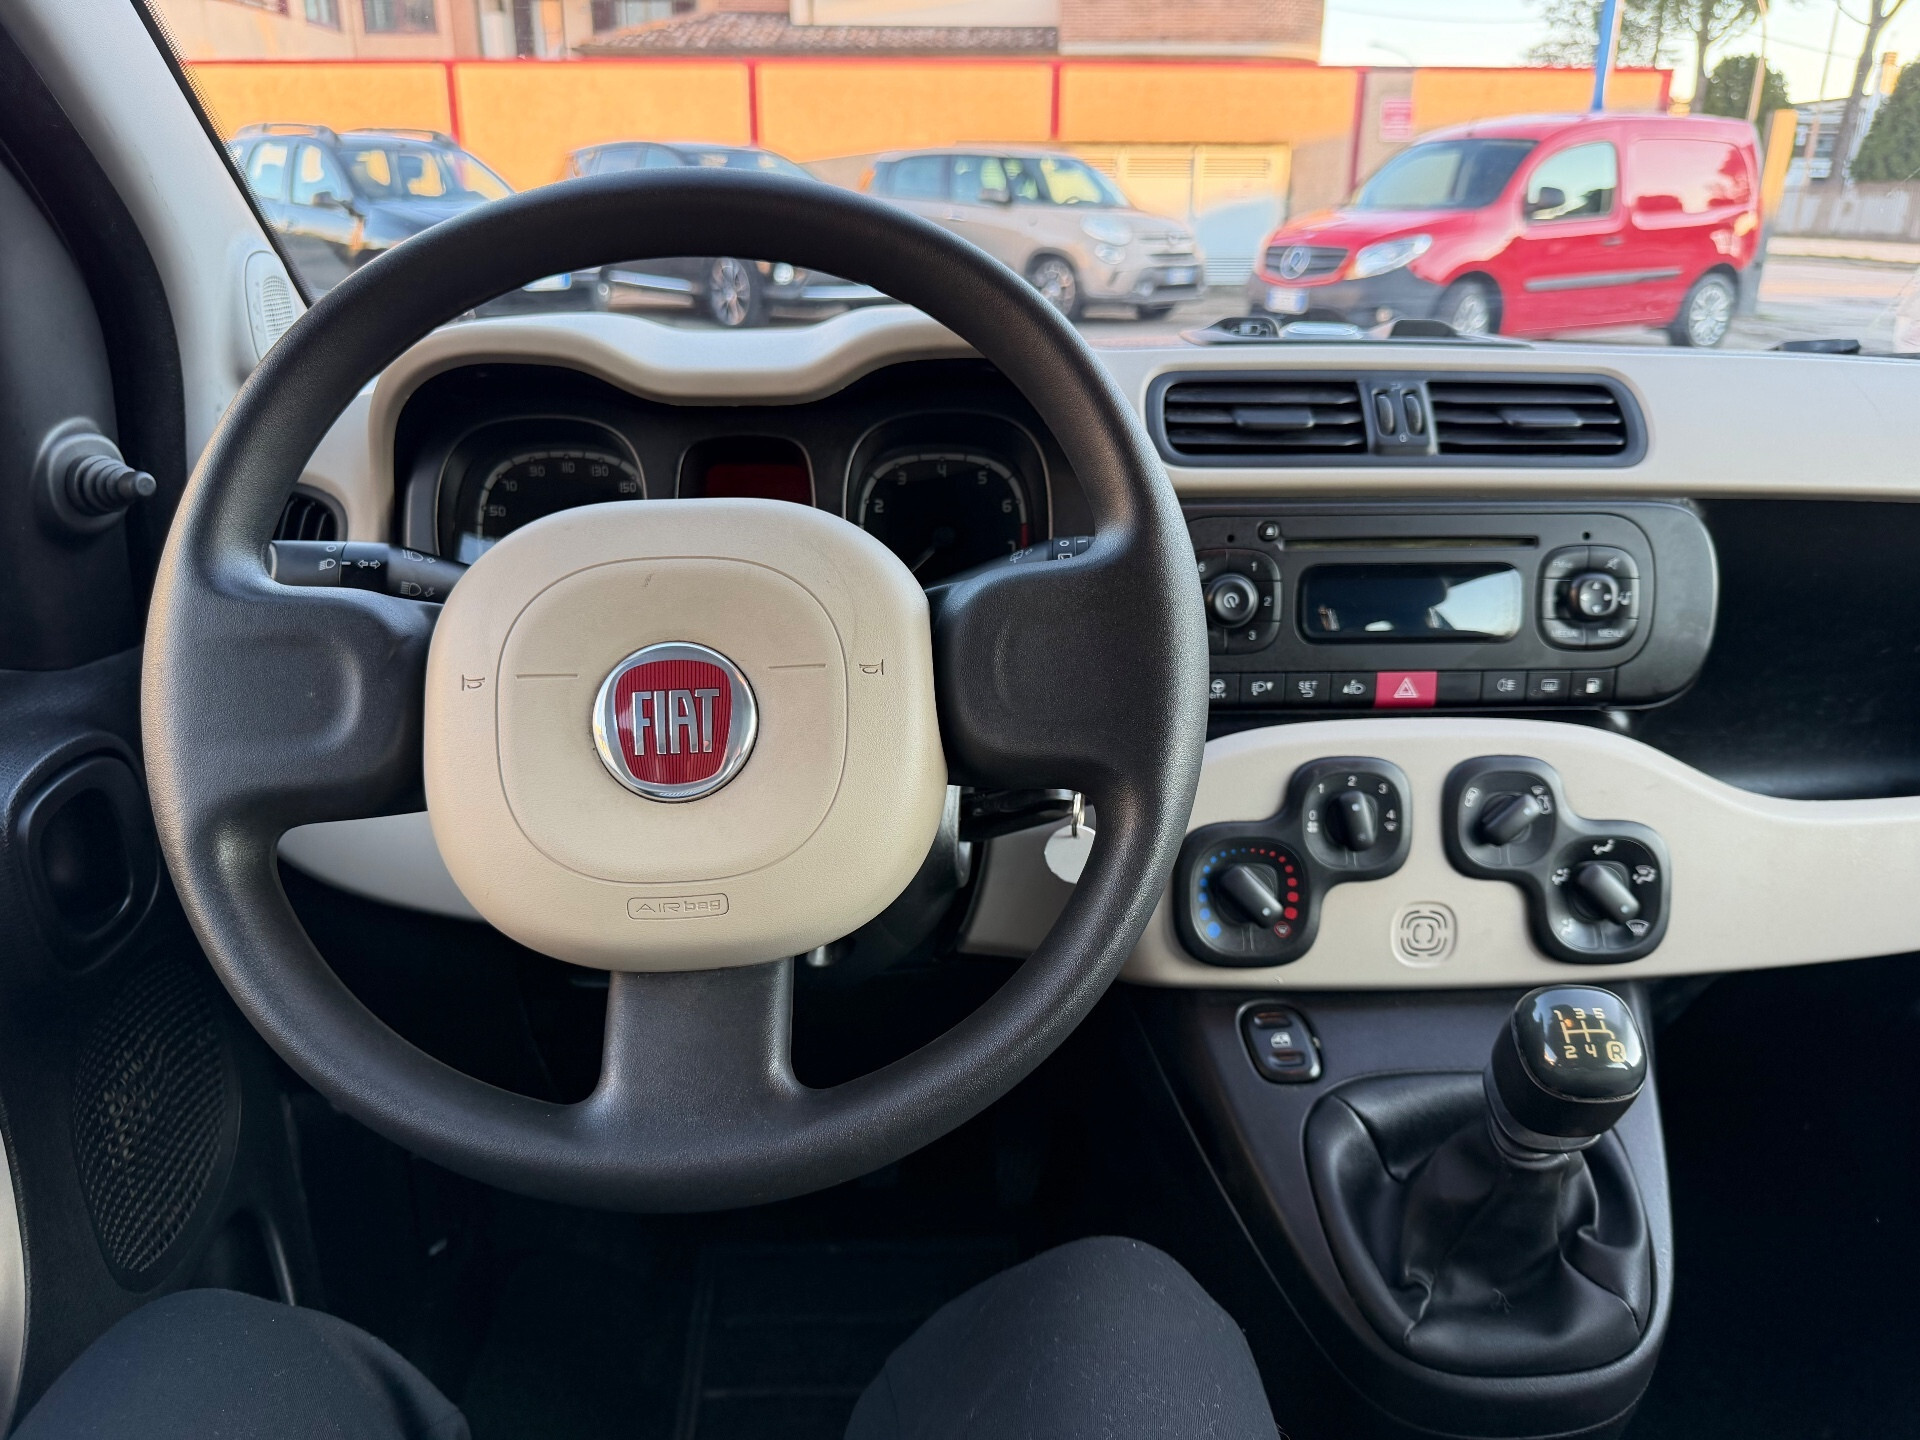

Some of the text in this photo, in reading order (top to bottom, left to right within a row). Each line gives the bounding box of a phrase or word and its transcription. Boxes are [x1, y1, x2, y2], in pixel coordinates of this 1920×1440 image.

[528, 465, 546, 478] 90
[561, 463, 576, 474] 110
[591, 465, 610, 478] 130
[936, 464, 948, 478] 4
[897, 471, 908, 486] 3
[977, 471, 989, 485] 5
[502, 480, 518, 492] 70
[619, 480, 637, 494] 150
[488, 505, 507, 518] 50
[873, 499, 885, 514] 2
[1001, 499, 1013, 514] 6
[1250, 561, 1258, 572] 1
[1263, 596, 1272, 607] 2
[1248, 630, 1257, 641] 3
[1597, 629, 1624, 638] MENU
[1298, 680, 1318, 690] SET
[1209, 692, 1227, 700] CITY
[631, 687, 720, 756] FIAT
[1347, 775, 1358, 787] 2
[1317, 783, 1325, 794] 1
[1378, 783, 1388, 794] 3
[1386, 809, 1397, 820] 4
[1553, 1007, 1606, 1021] 1 3 5
[1563, 1043, 1623, 1060] 2 4 R
